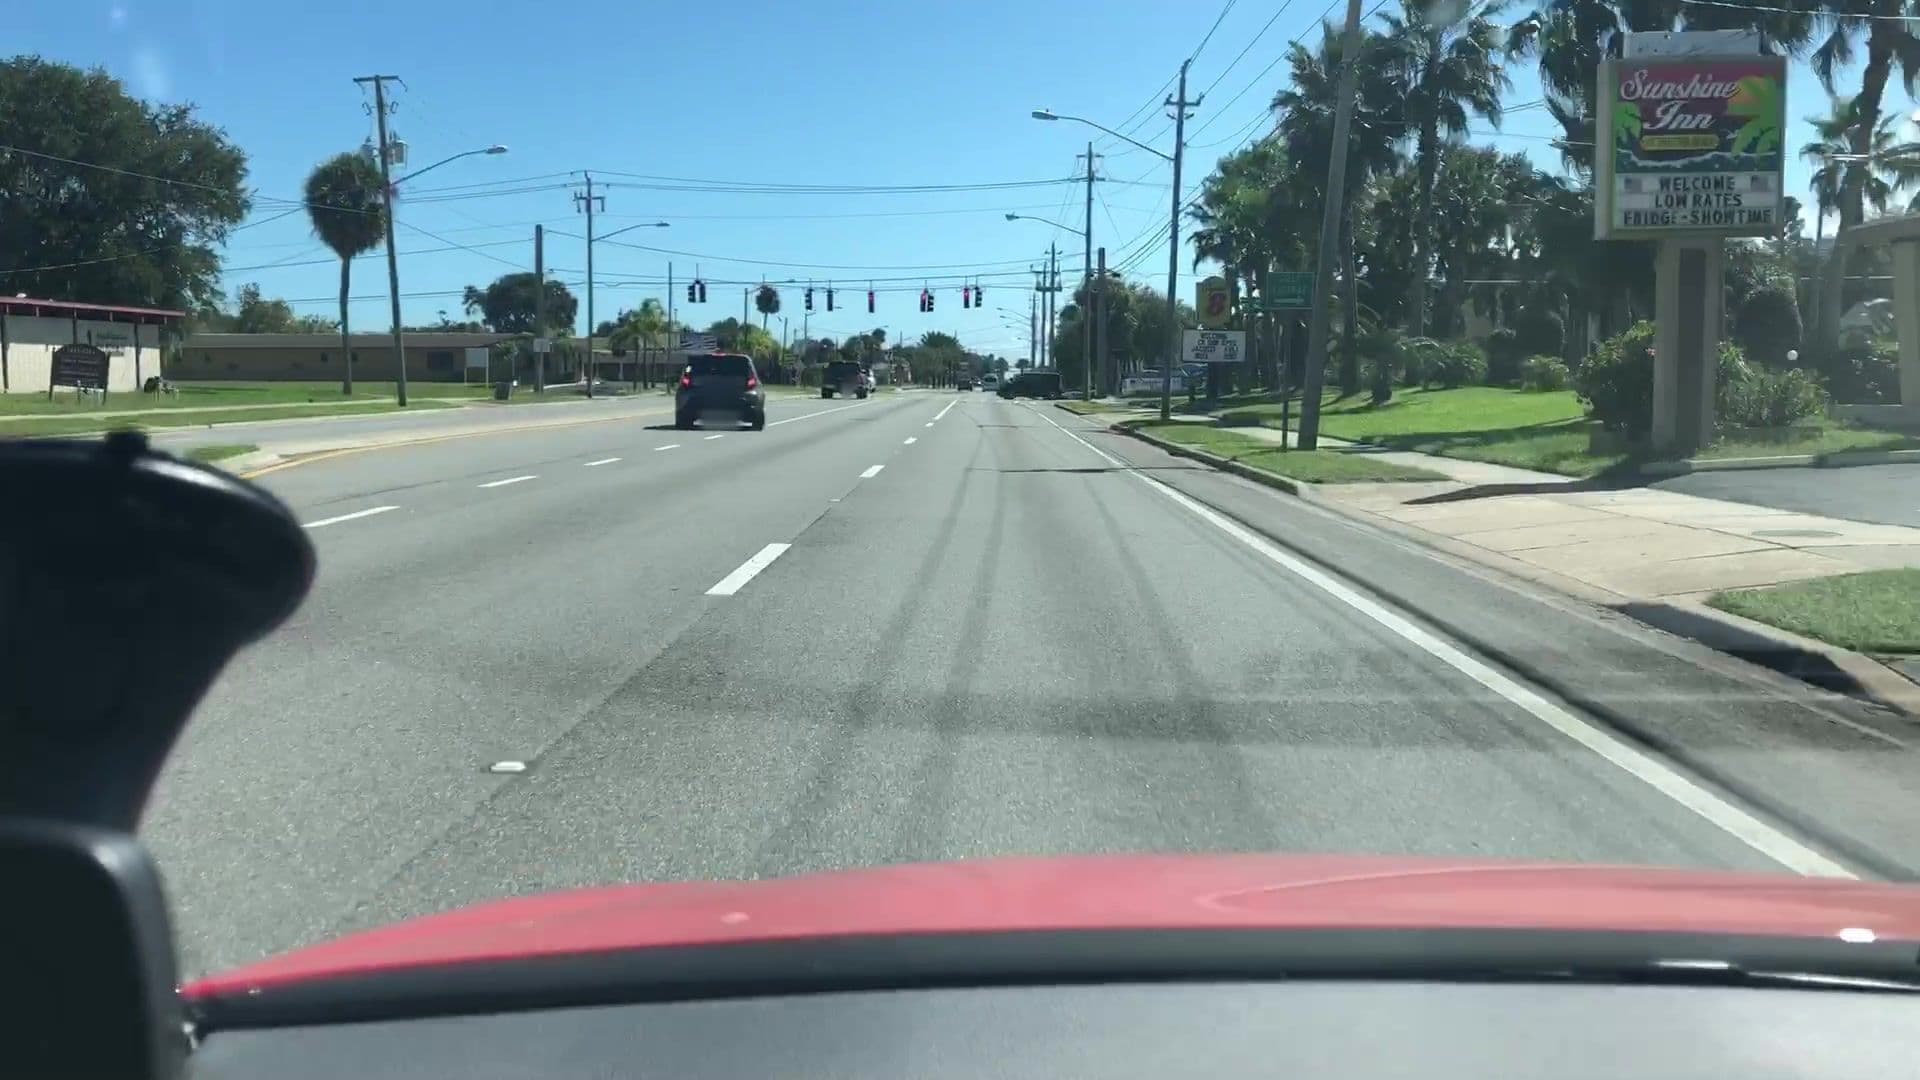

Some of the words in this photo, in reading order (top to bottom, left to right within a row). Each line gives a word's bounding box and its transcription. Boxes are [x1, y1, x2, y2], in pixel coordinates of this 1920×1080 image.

[1621, 69, 1740, 100] Sunshine
[1643, 100, 1717, 130] Inn
[1660, 176, 1736, 191] WELCOME
[1655, 194, 1688, 208] LOW
[1693, 193, 1744, 207] RATES
